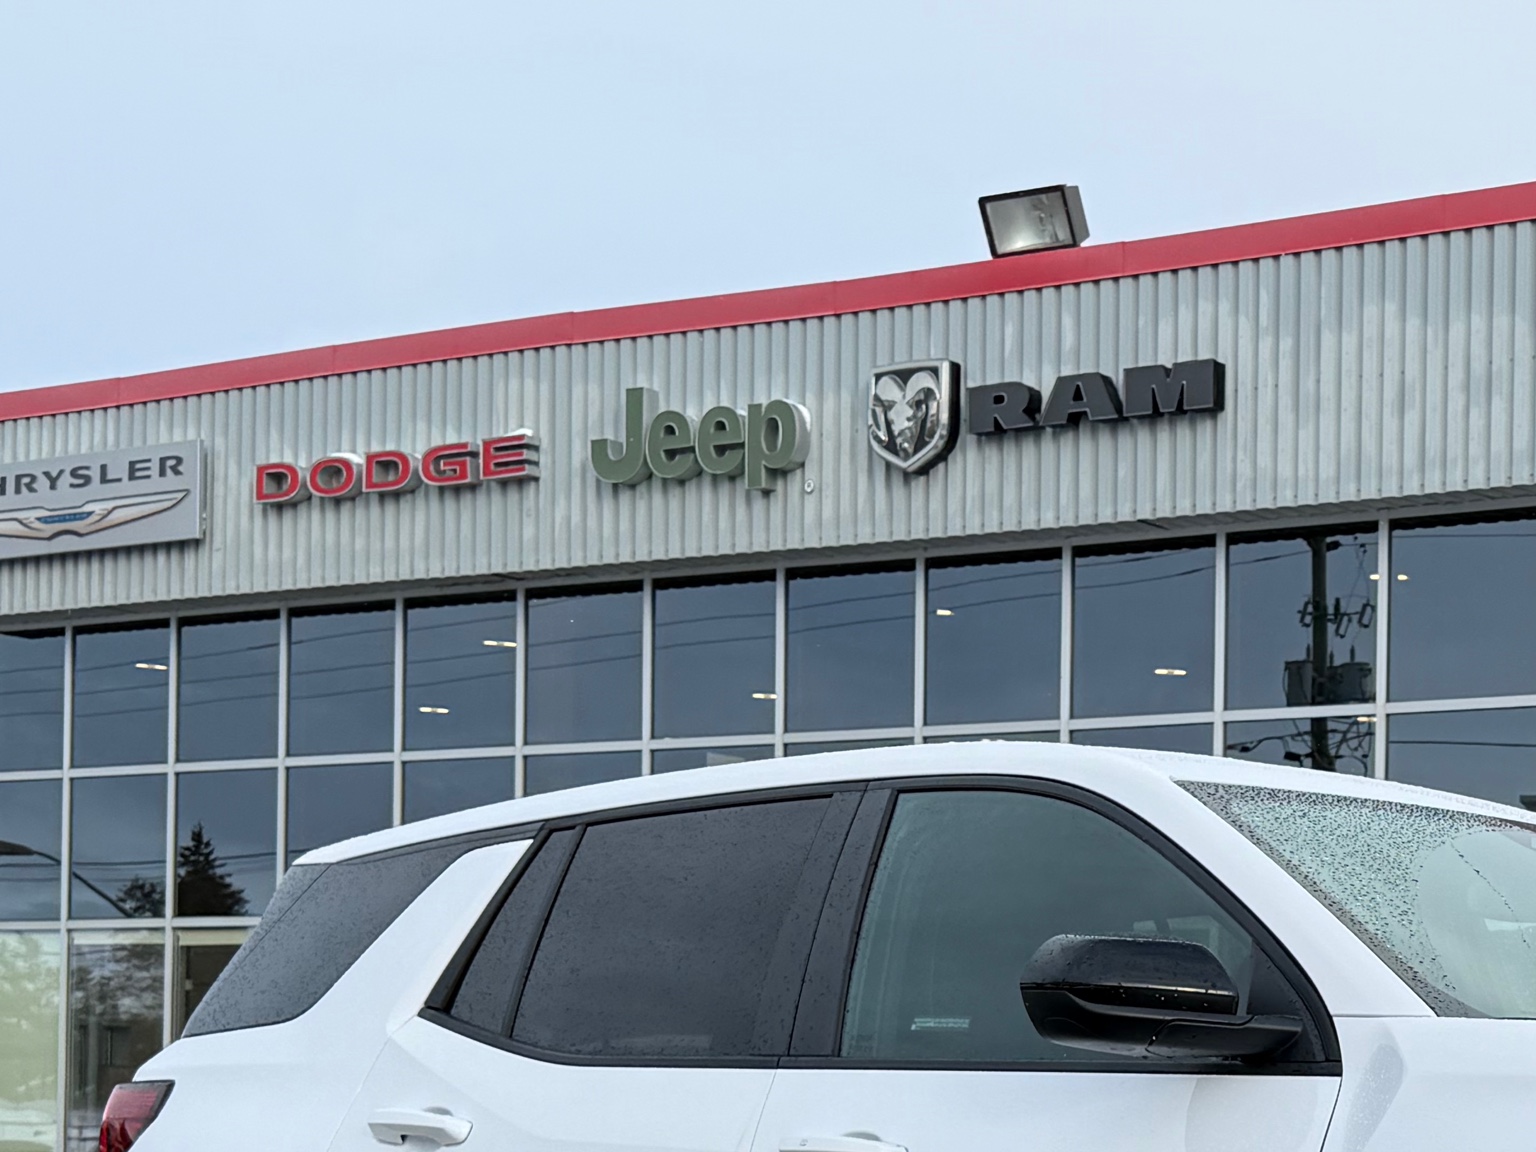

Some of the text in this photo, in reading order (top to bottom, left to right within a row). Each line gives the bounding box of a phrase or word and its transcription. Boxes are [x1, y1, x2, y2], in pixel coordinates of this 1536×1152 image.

[966, 359, 1226, 434] RAM
[254, 434, 535, 502] DODGE
[590, 387, 808, 491] Jeep
